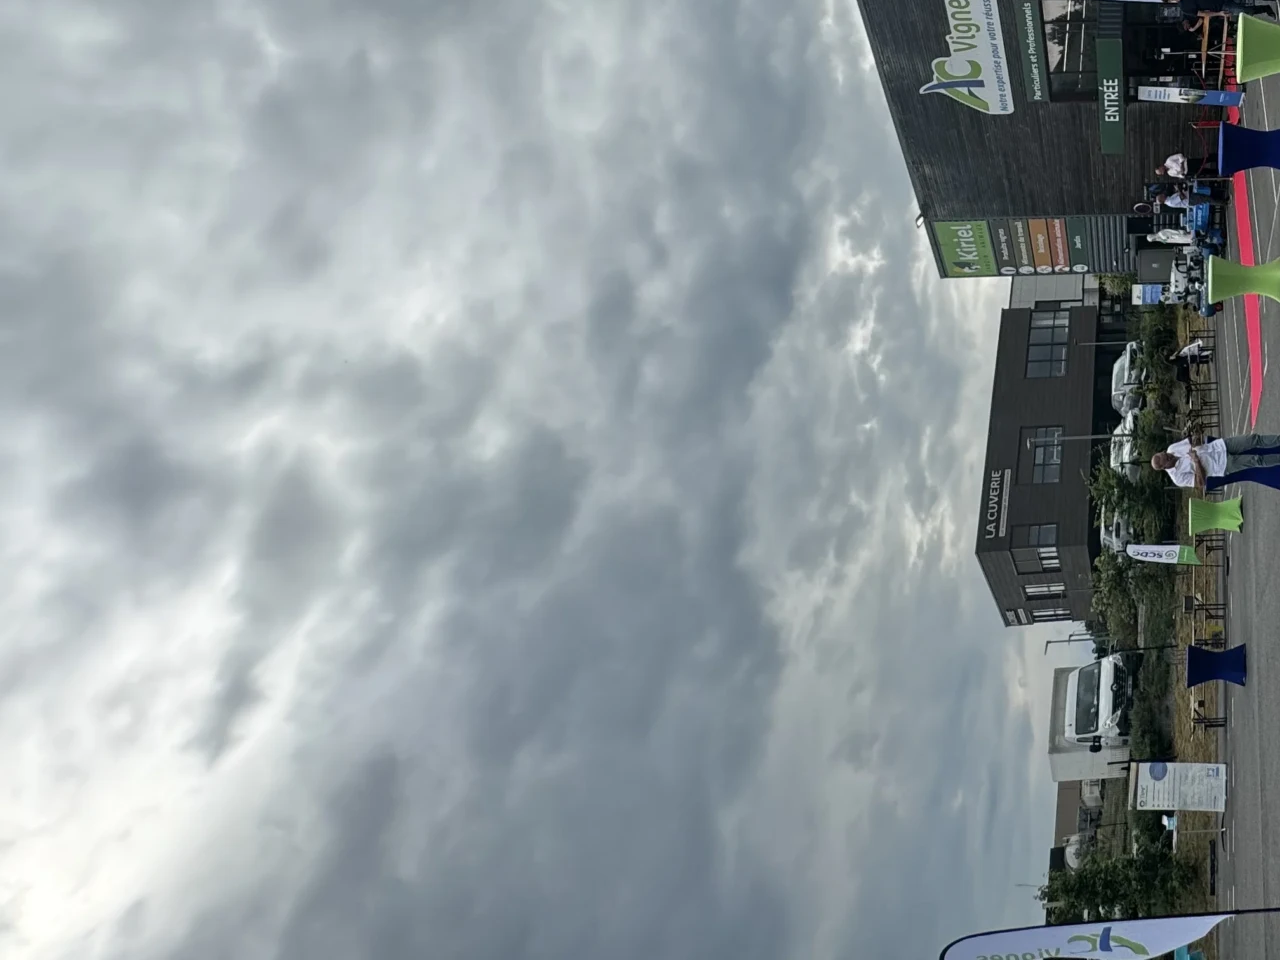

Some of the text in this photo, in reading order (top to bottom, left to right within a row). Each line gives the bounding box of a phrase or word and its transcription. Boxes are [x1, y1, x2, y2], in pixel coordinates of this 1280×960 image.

[985, 22, 997, 40] votre
[1023, 2, 1036, 54] Professionnels
[990, 42, 1002, 60] pour
[992, 60, 1006, 92] expertise
[1031, 63, 1042, 100] Particuliers
[998, 93, 1009, 112] Notre
[1100, 78, 1120, 122] ENTRÉE
[950, 224, 980, 260] Kiriel
[985, 470, 1002, 539] LA CUVERIE
